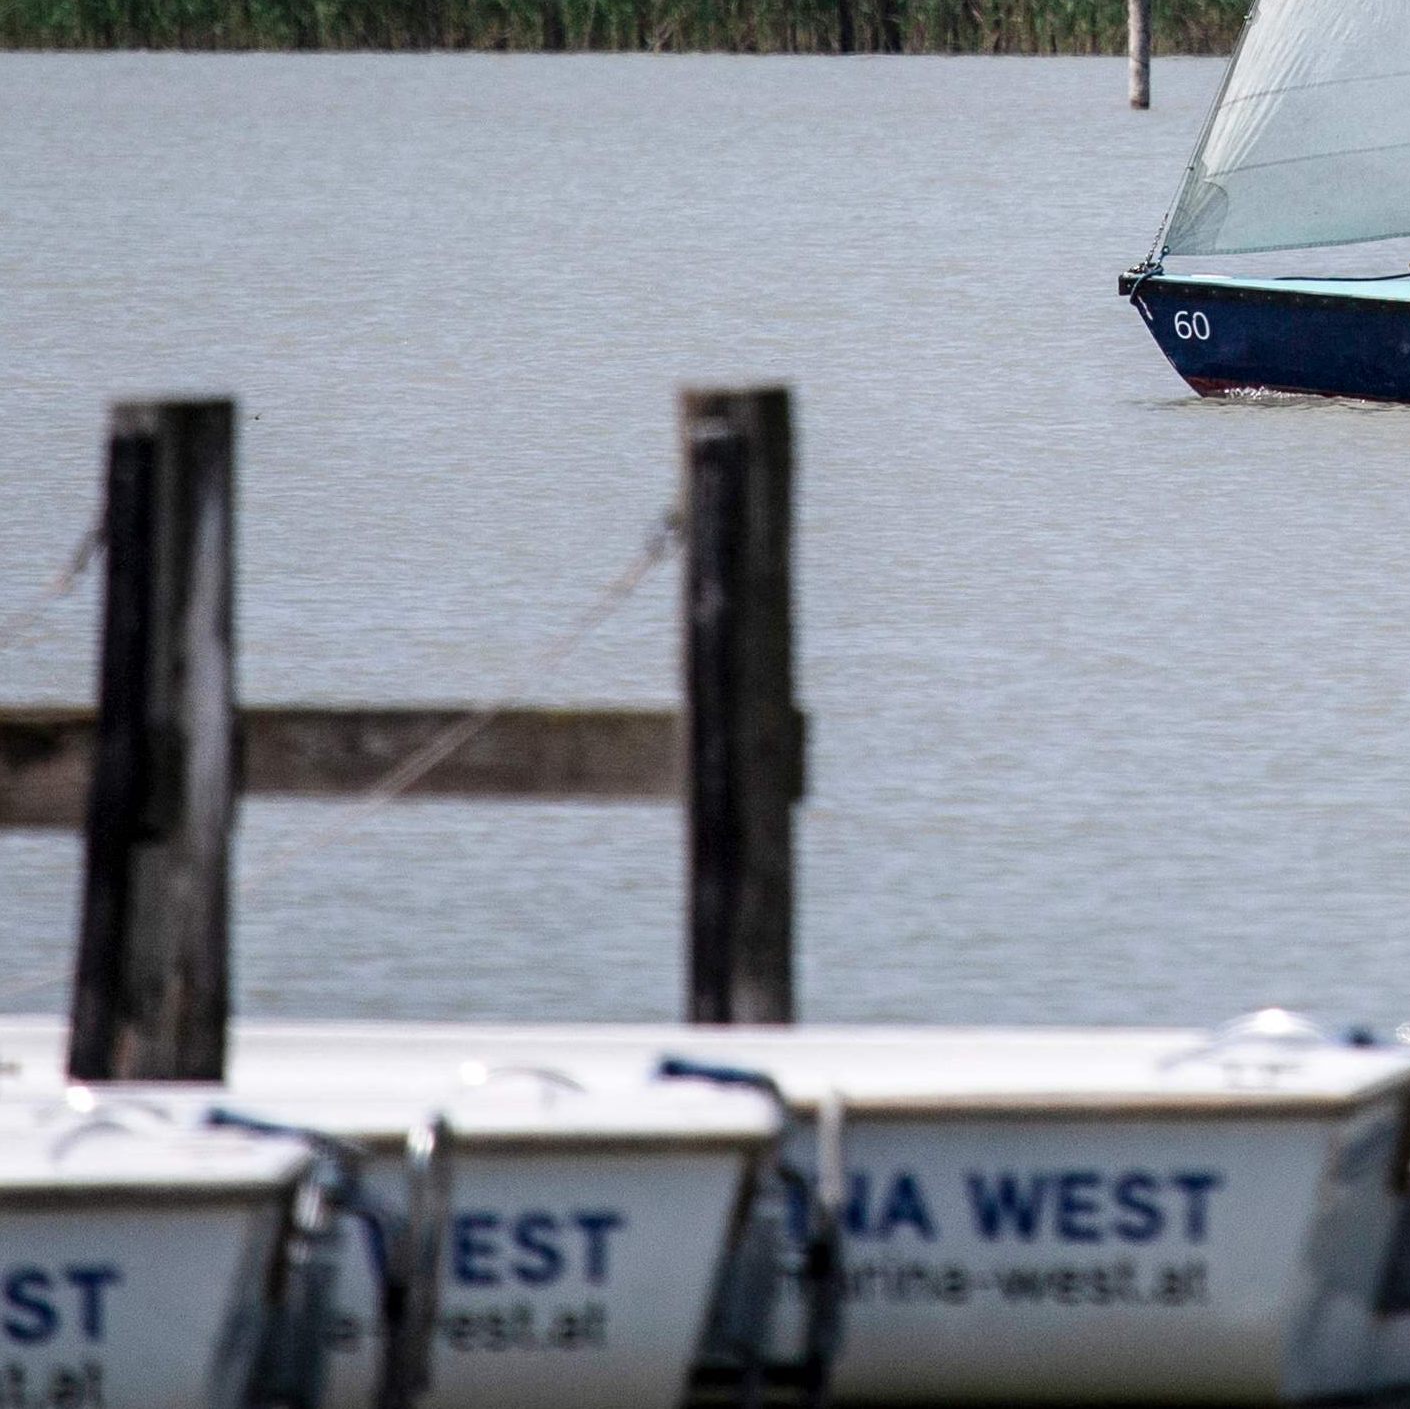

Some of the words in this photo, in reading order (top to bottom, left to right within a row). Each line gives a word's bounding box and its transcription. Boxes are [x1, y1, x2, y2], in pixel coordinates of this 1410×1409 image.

[1174, 310, 1210, 340] 60
[964, 1170, 1221, 1244] WEST
[450, 1211, 626, 1286] EST
